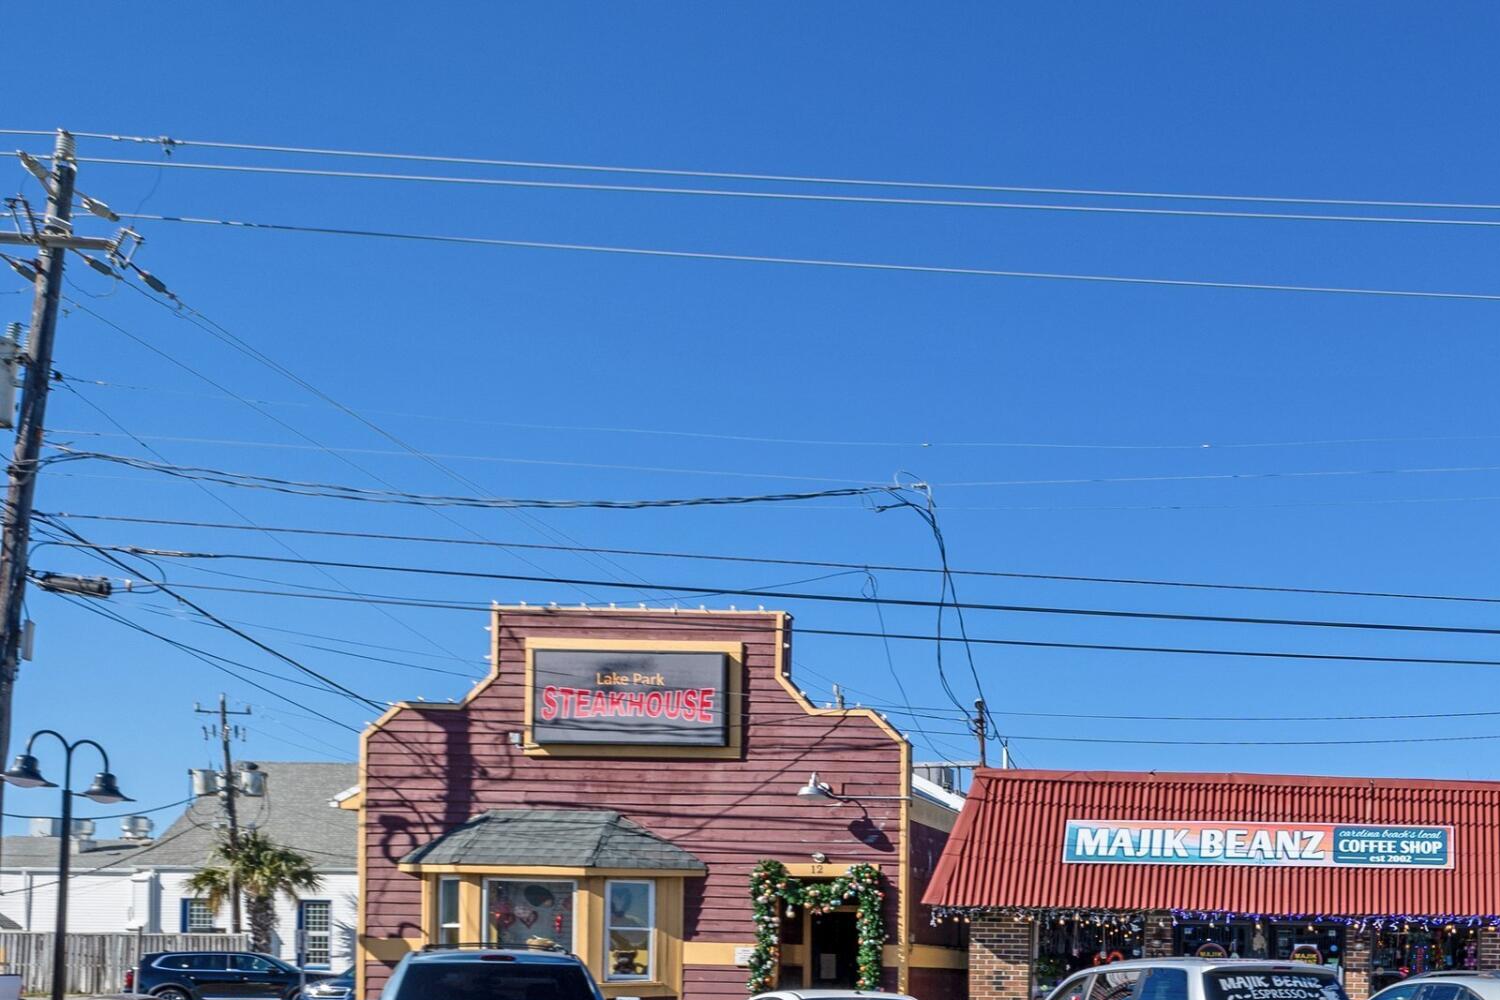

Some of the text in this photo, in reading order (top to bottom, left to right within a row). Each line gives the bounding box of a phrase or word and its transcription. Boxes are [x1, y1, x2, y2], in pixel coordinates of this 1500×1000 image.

[596, 672, 665, 687] Lake Park
[541, 685, 716, 723] STEAKHOUSE
[1418, 829, 1442, 839] local
[1075, 828, 1326, 861] MAJIK BEANZ
[1339, 839, 1443, 854] COFFEE SHOP
[1369, 854, 1412, 863] est 2002
[811, 865, 823, 874] 12
[1219, 976, 1322, 991] MAJIK BEANZ
[1251, 989, 1307, 999] ESPRESSO
